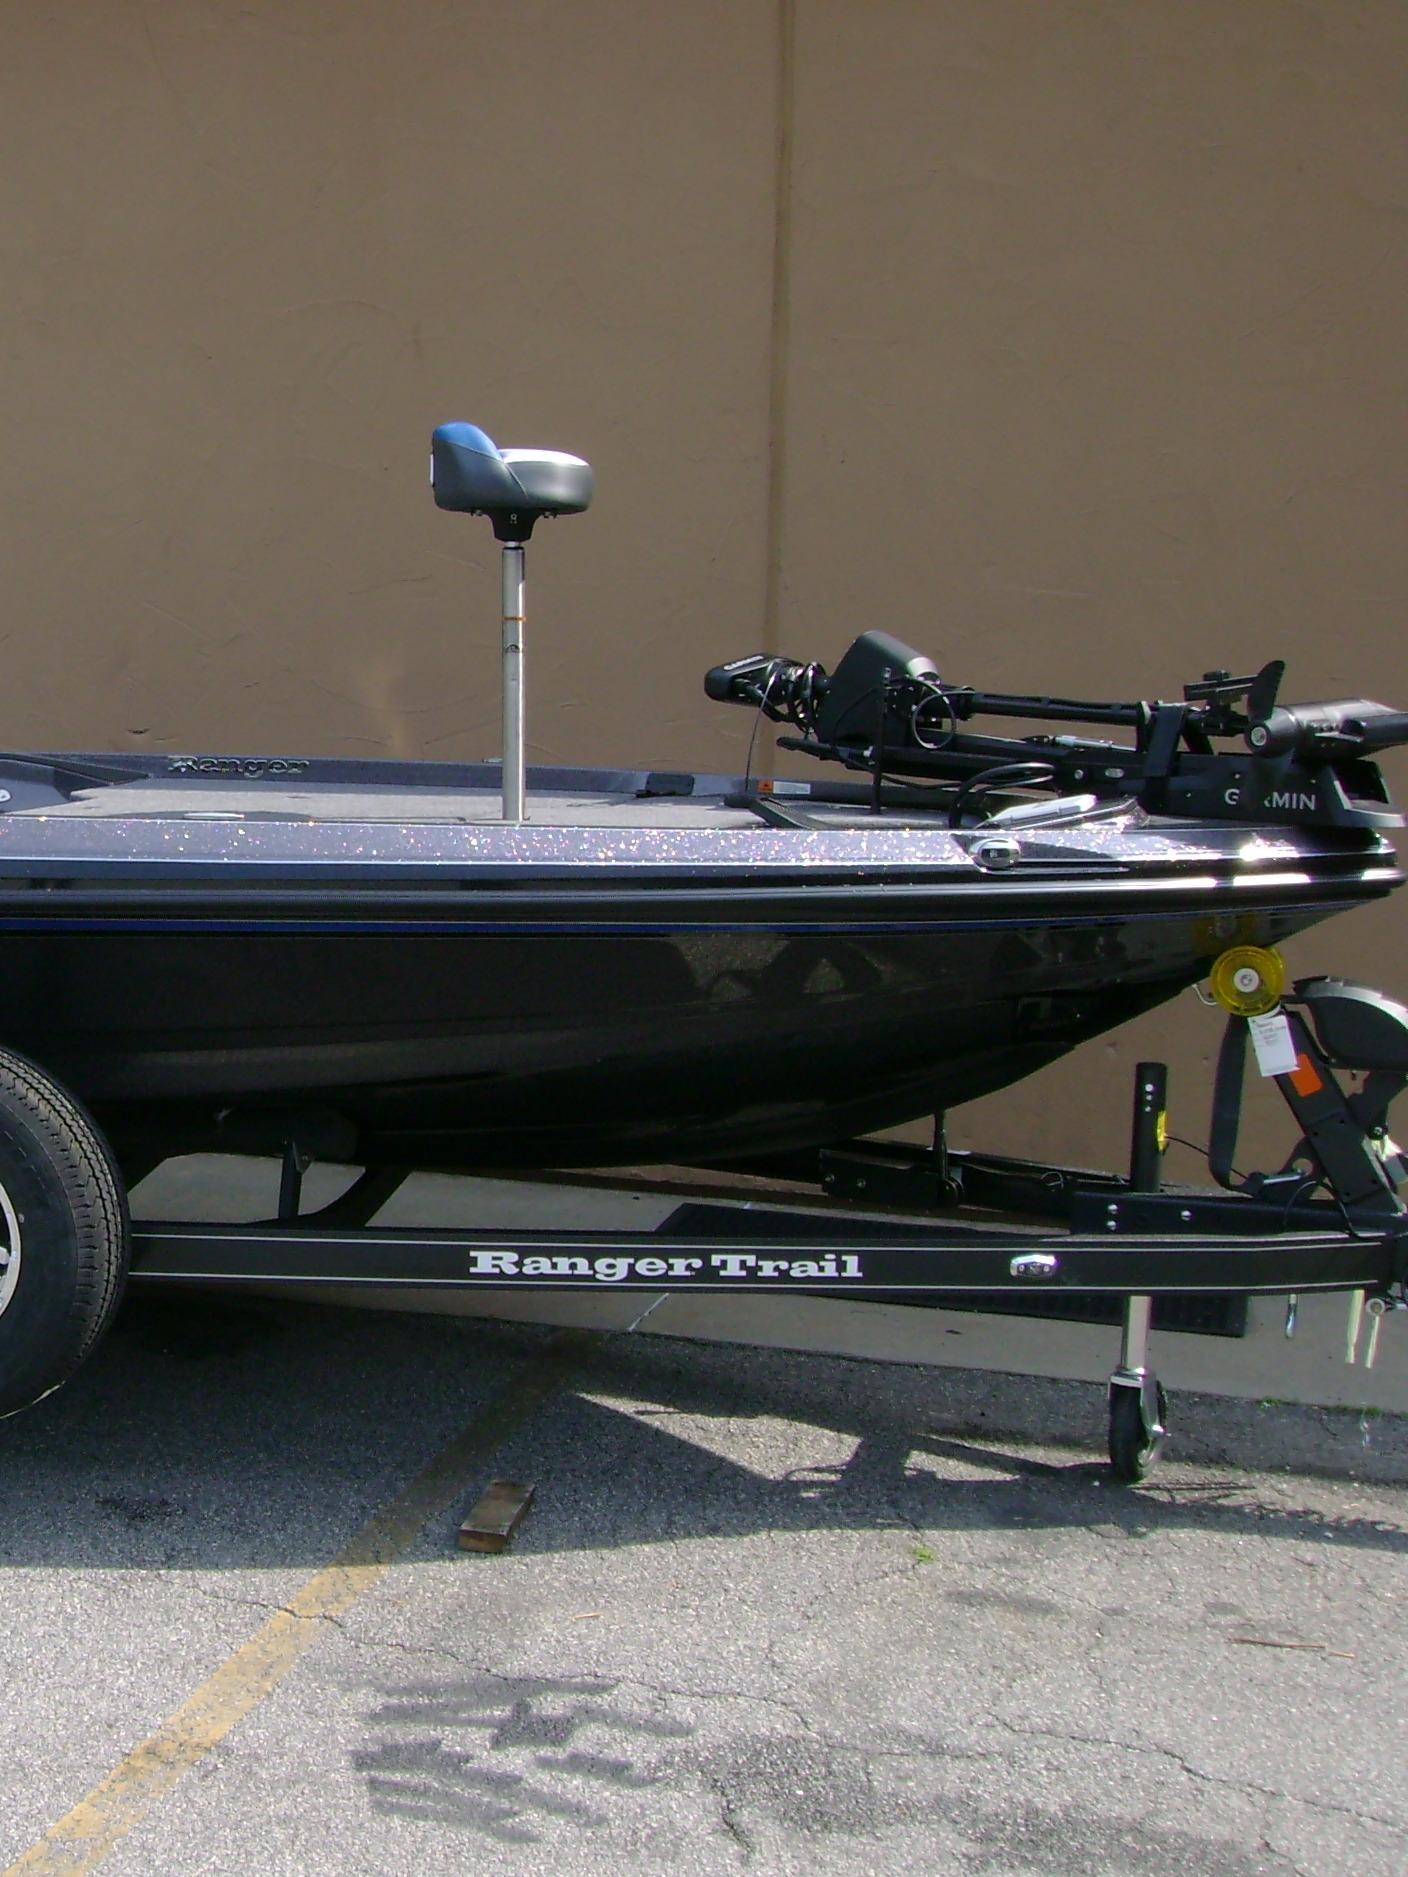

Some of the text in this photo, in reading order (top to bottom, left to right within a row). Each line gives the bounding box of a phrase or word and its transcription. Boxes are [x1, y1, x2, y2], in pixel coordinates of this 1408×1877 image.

[167, 755, 310, 779] Ranger
[1224, 788, 1316, 811] GMIN
[468, 1250, 864, 1281] Ranger Trail
